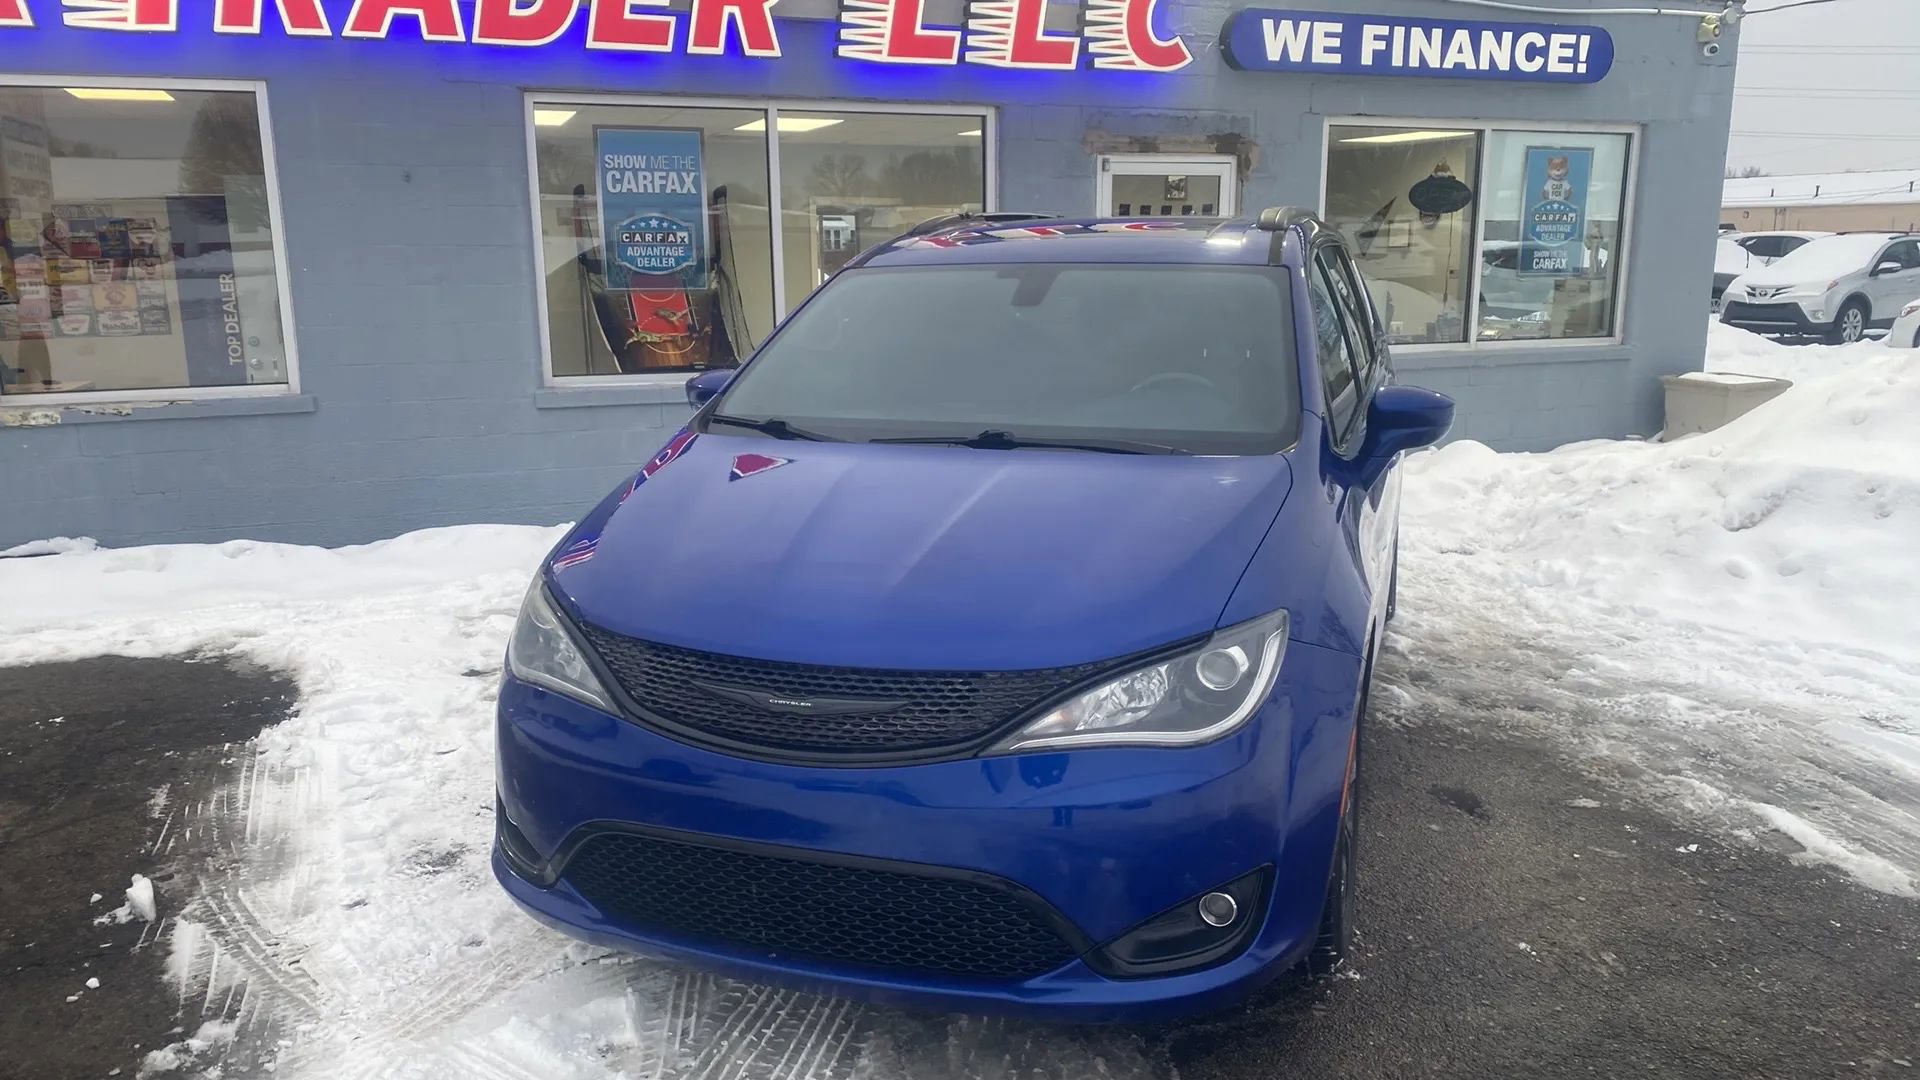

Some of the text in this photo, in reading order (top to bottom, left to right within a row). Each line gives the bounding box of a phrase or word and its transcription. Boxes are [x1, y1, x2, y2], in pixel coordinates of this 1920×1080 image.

[837, 0, 1194, 71] LLC
[1262, 18, 1591, 74] WE FINANCE!
[604, 154, 696, 170] SHOW ME THE
[606, 170, 697, 194] CARFAX
[1534, 213, 1576, 222] CARFAX
[622, 232, 688, 244] CARFAX
[626, 246, 685, 257] ADVANTAGE
[637, 257, 676, 268] DEALER
[1532, 257, 1568, 270] CARFAX
[219, 273, 242, 366] TOP DEALER
